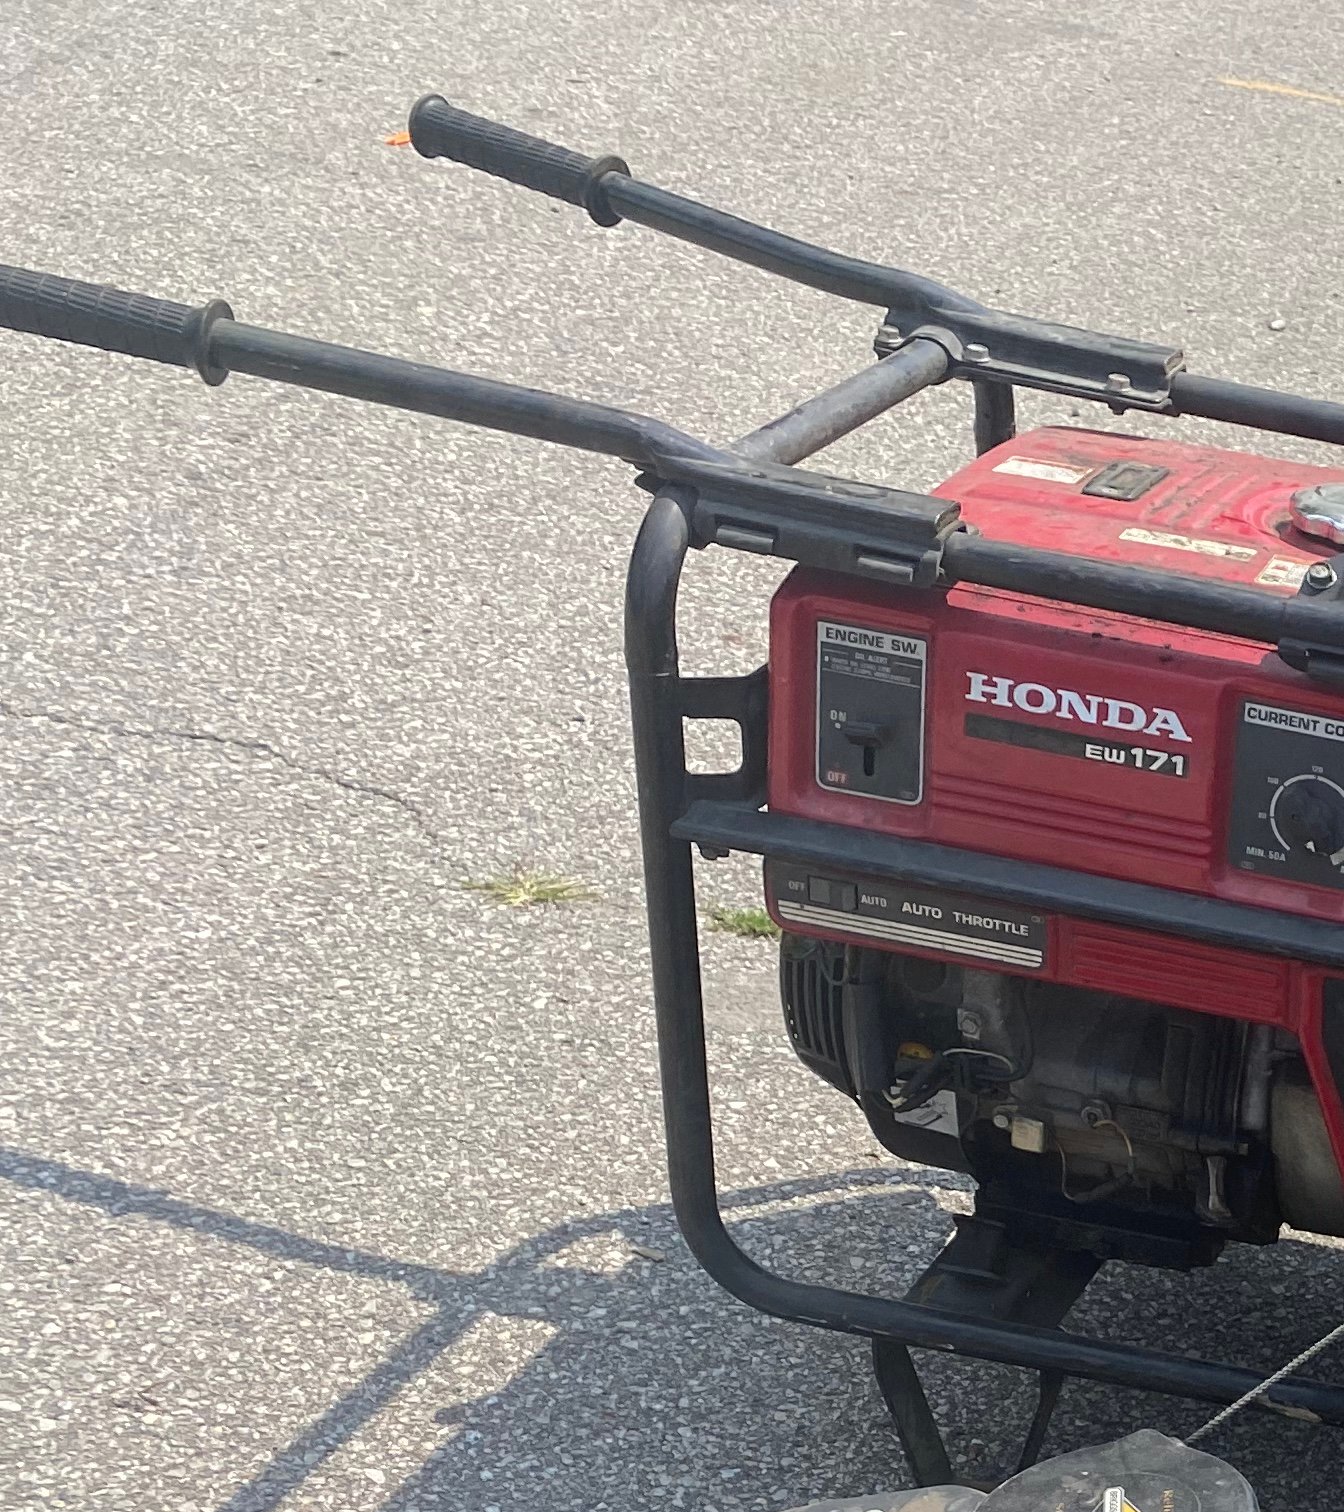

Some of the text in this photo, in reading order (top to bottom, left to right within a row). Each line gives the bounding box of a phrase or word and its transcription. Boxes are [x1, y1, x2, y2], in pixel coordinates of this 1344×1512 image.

[826, 627, 884, 648] ENGINE
[830, 709, 847, 722] ON
[965, 671, 1192, 743] HONDA
[1247, 707, 1320, 732] CURRENT
[828, 771, 847, 783] OFF
[860, 894, 887, 908] AUTO
[901, 901, 1029, 937] AUTO THROTTLE
